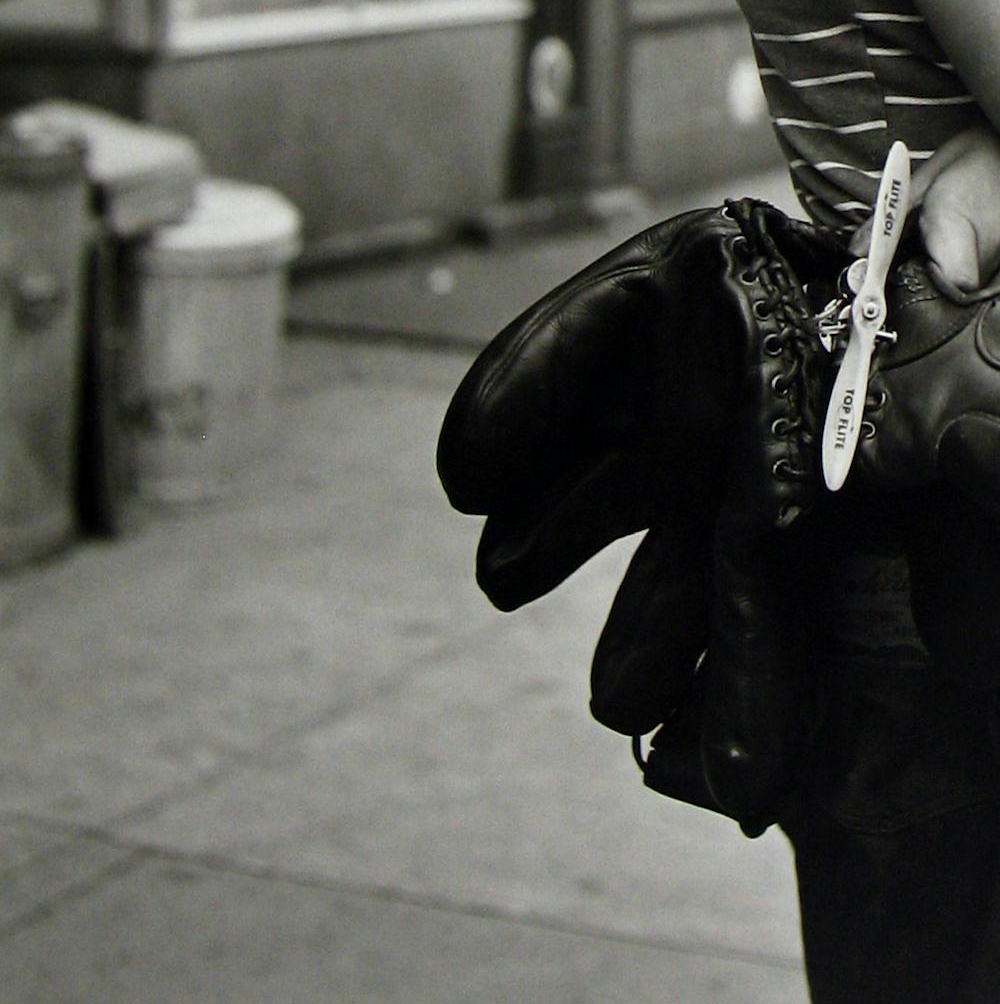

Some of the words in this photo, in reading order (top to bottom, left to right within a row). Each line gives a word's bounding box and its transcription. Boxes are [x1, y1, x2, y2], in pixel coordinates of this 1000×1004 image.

[888, 178, 901, 209] FLITE
[883, 211, 894, 237] TOP
[842, 388, 855, 414] TOP
[834, 418, 849, 450] FLITE
